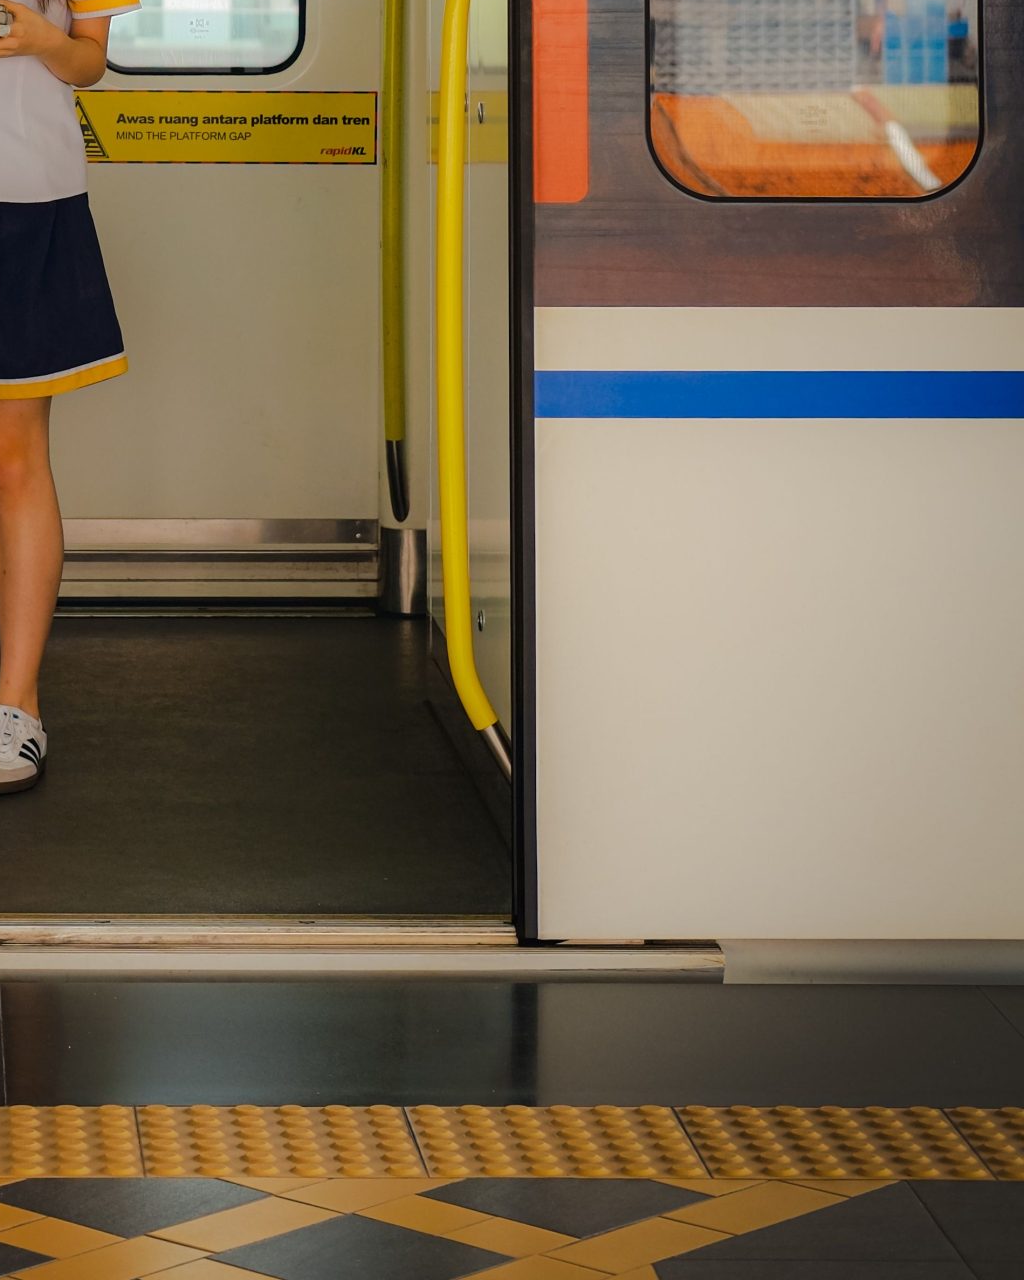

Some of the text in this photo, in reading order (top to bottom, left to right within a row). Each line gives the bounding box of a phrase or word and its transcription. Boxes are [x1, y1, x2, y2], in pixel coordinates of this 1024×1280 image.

[116, 114, 370, 127] Awas ruang antara platform dan tren
[116, 131, 252, 140] MIND THE PLATFORM GAP
[320, 147, 367, 156] rapidKL
